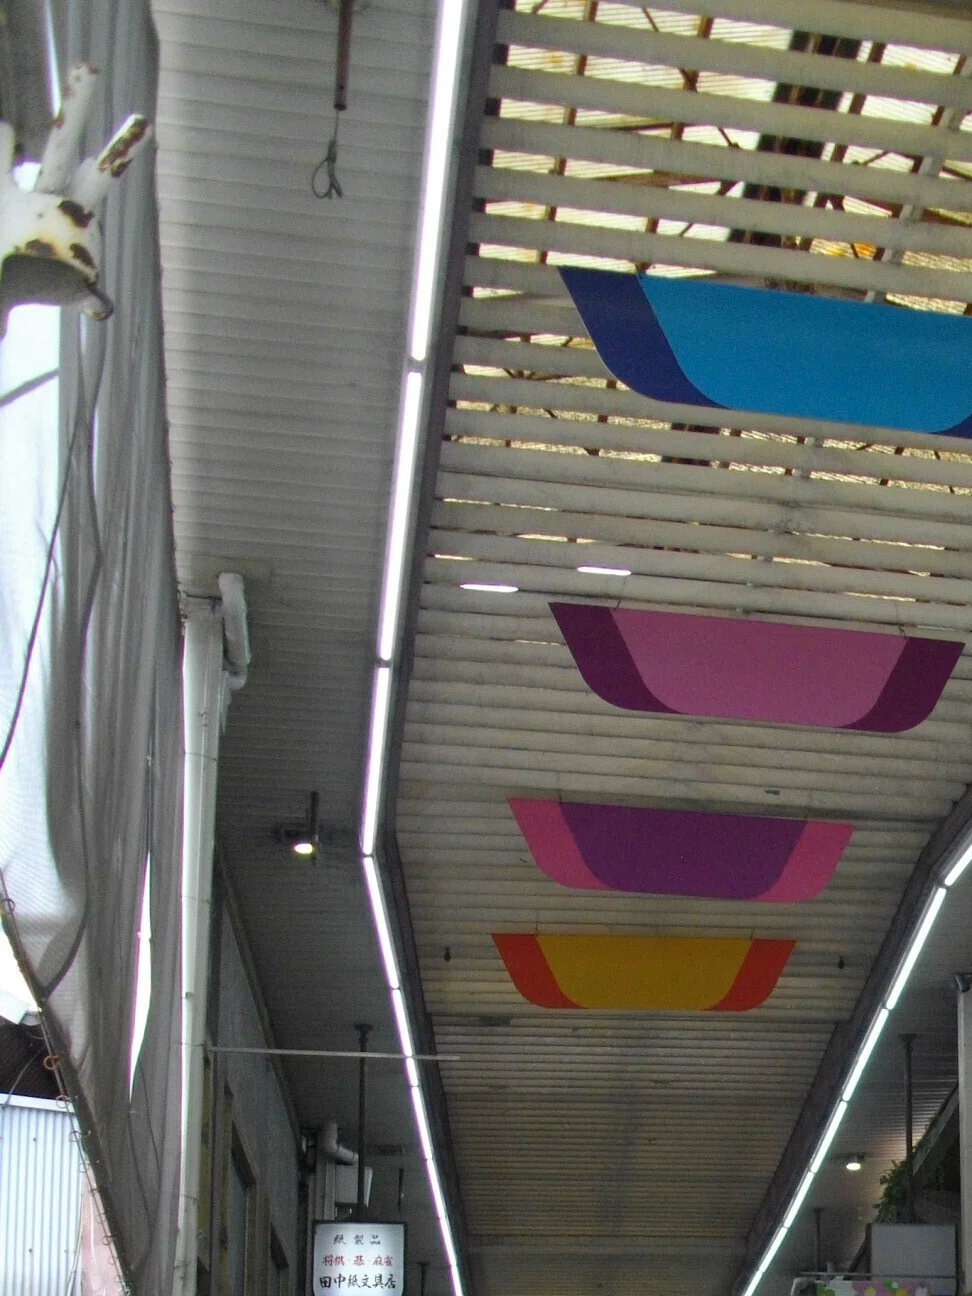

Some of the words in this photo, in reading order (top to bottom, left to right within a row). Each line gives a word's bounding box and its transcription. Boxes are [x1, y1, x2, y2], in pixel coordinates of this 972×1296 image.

[333, 1234, 381, 1246] 紙製品
[319, 1273, 397, 1290] 田中紙文具店
